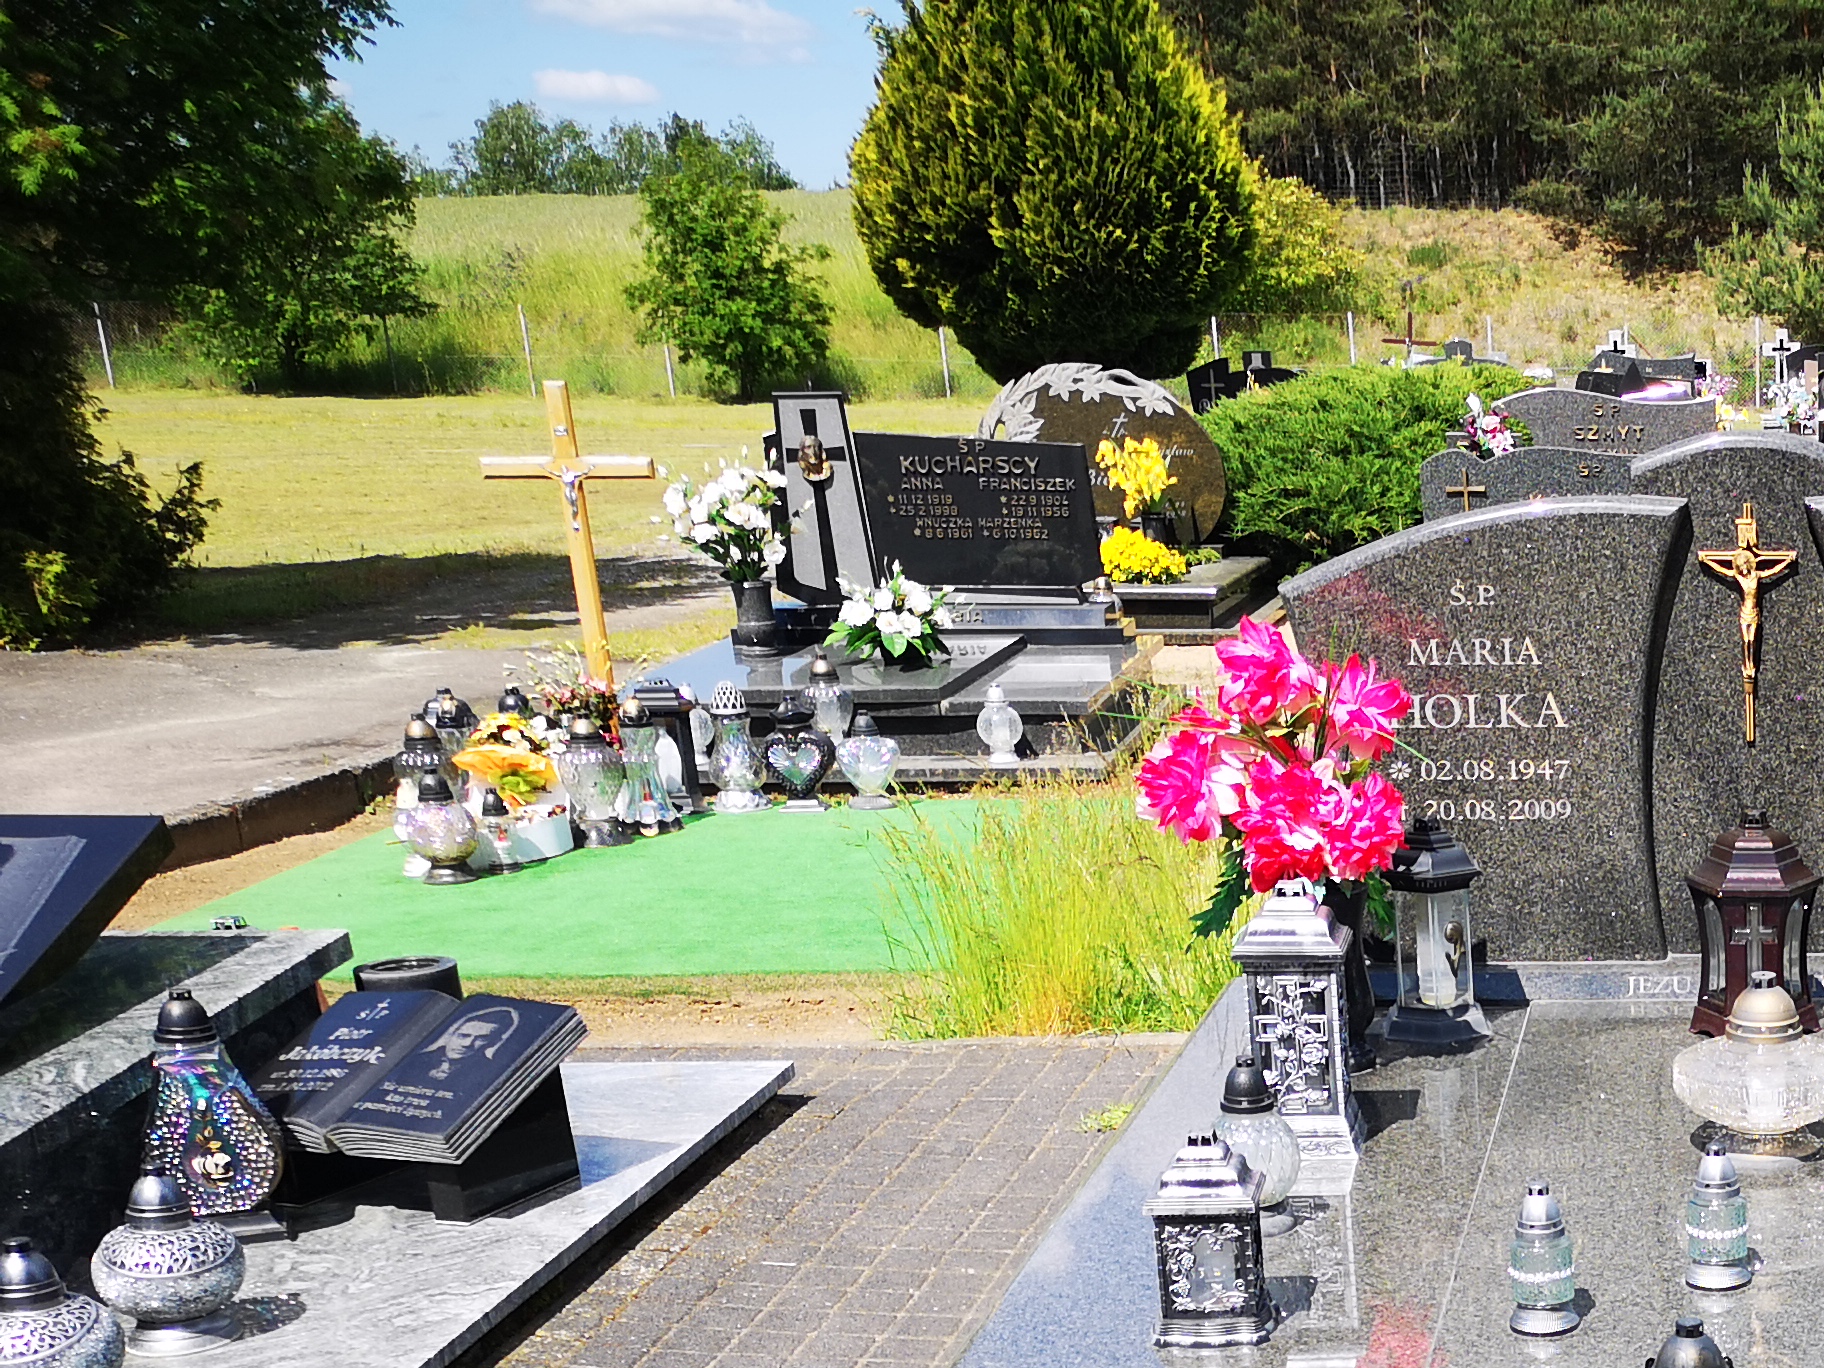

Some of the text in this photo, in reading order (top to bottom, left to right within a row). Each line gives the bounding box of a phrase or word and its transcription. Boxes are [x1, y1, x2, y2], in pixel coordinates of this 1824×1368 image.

[900, 456, 1040, 474] KUCHARSCY
[901, 477, 944, 490] ANNA
[978, 477, 1077, 491] FRANCISZEK
[916, 517, 973, 528] WNUCZKA
[1407, 636, 1543, 667] MARIA
[1421, 758, 1571, 781] 02.08.1947
[1424, 799, 1573, 821] 20.08.2009
[1627, 975, 1691, 997] JEZU
[328, 1026, 374, 1040] Piotr
